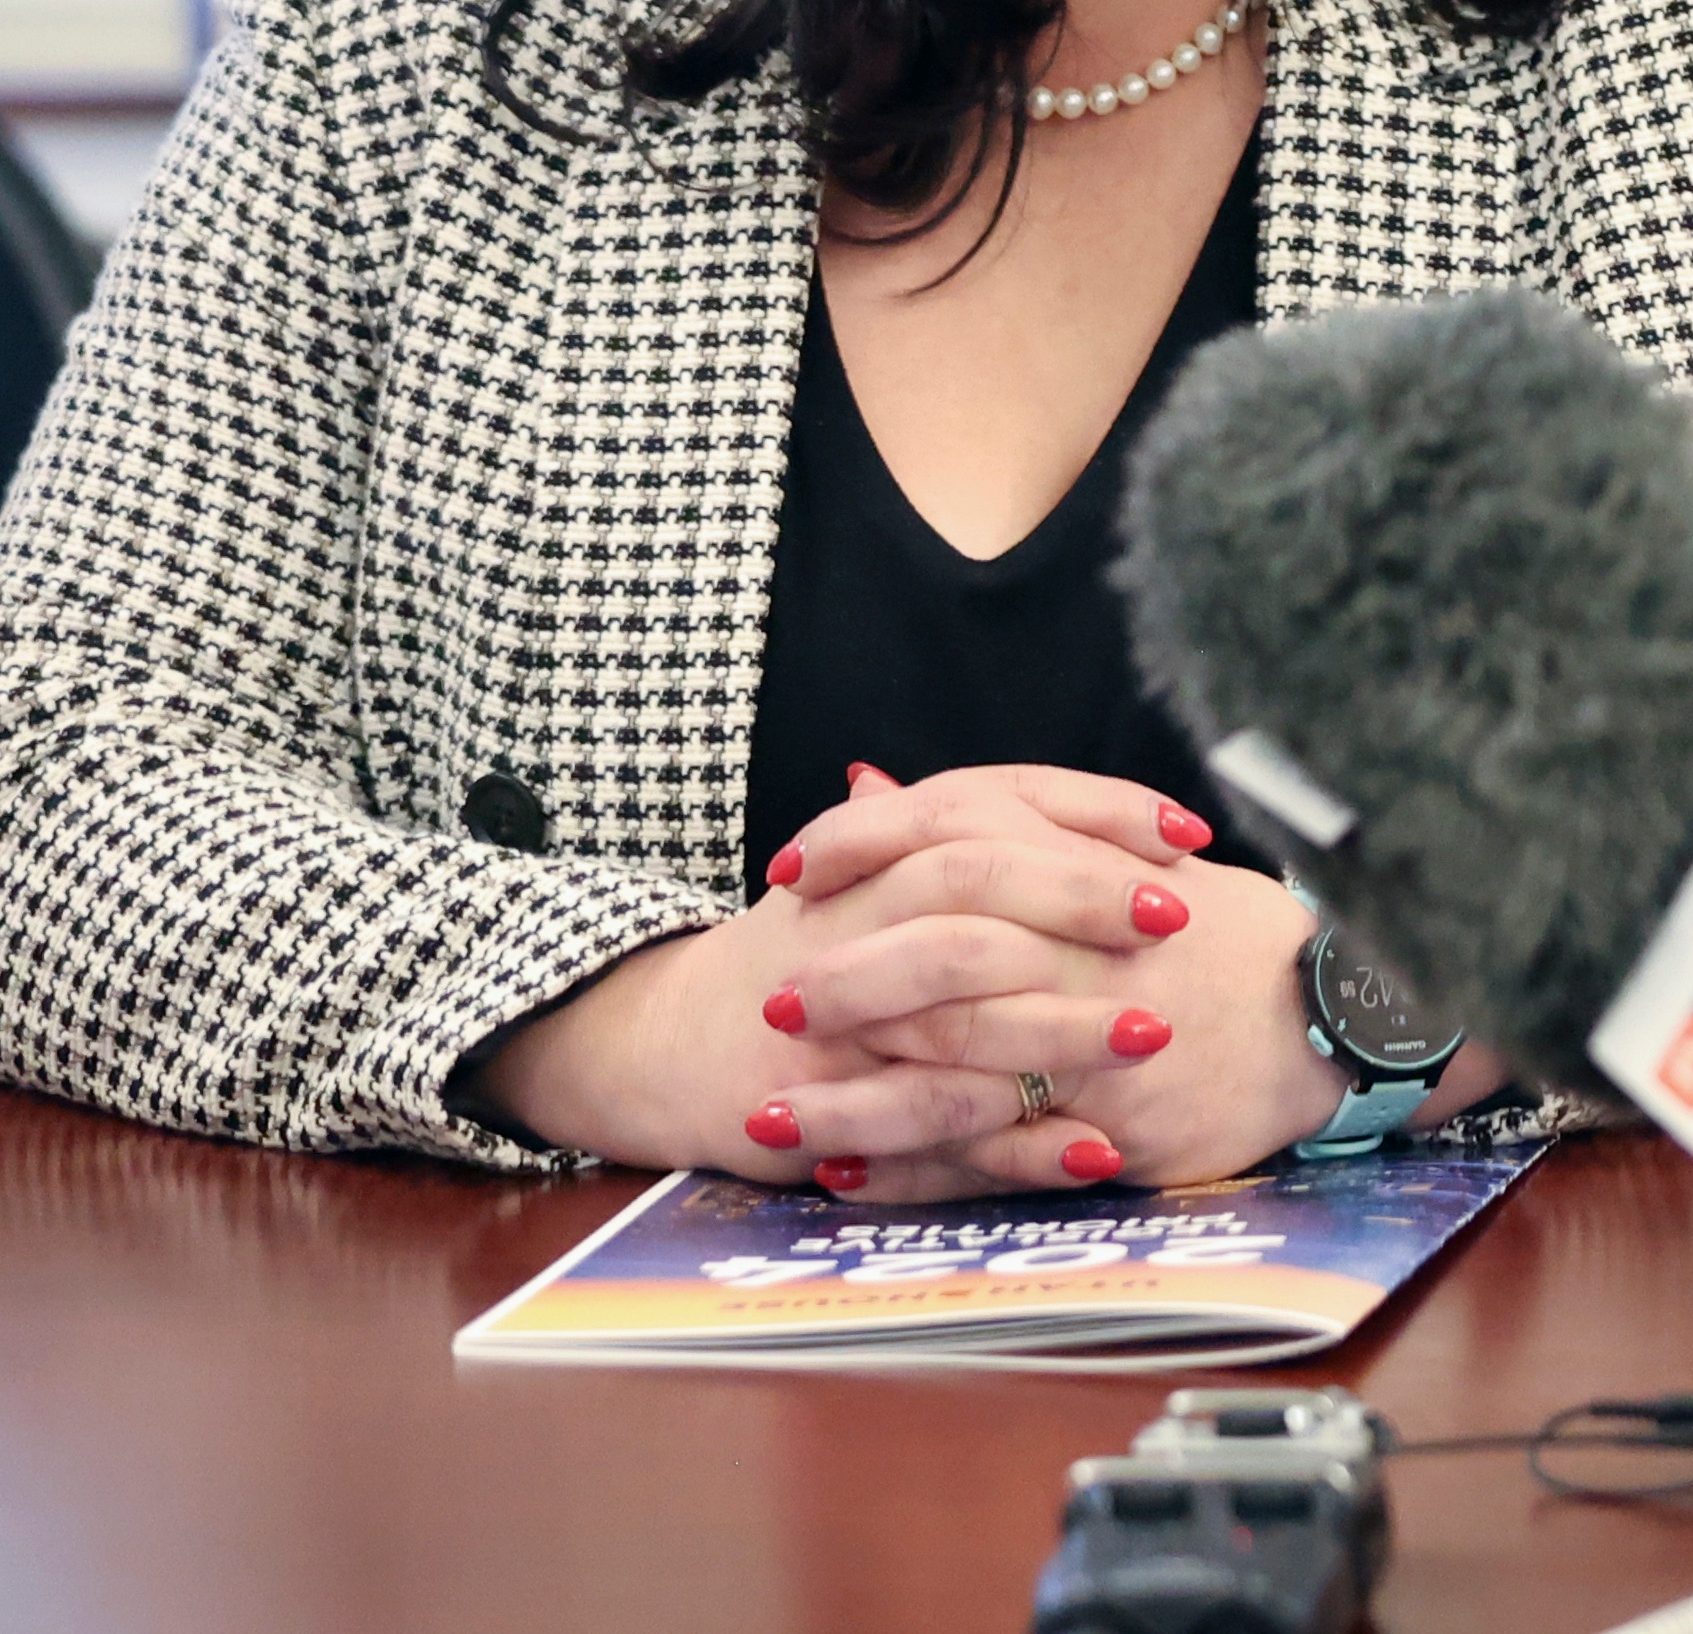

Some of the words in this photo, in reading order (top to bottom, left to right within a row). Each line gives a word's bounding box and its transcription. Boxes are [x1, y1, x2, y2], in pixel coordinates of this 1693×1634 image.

[1384, 1040, 1426, 1052] GARMIN
[788, 1220, 1249, 1254] LEGISLATIVE
[836, 1211, 1237, 1240] PRIORITIES
[699, 1234, 1287, 1288] 2024
[987, 1277, 1161, 1297] UTAH
[717, 1289, 931, 1312] HOUSE
